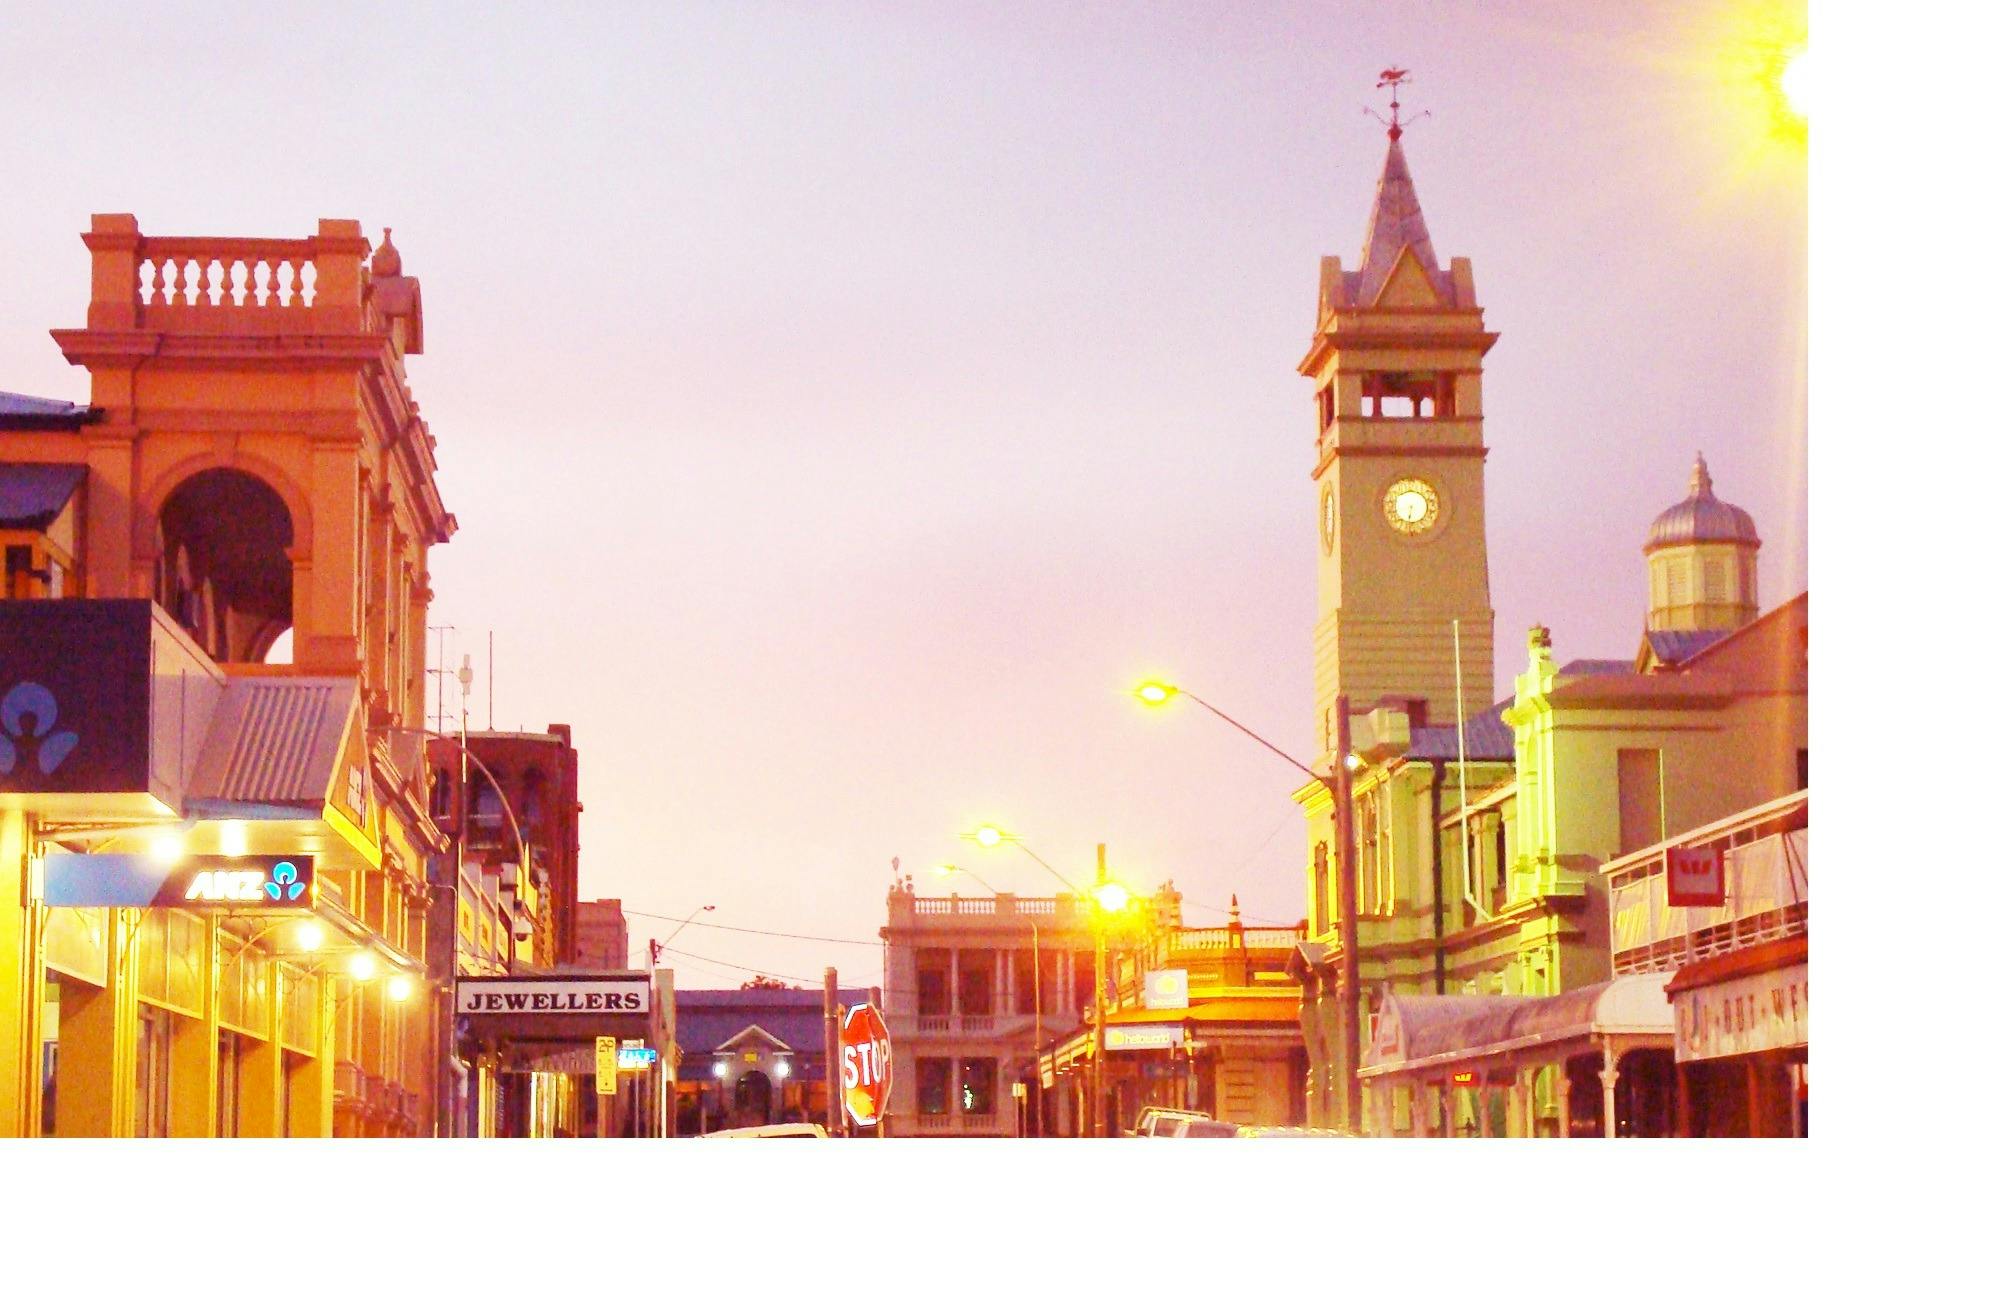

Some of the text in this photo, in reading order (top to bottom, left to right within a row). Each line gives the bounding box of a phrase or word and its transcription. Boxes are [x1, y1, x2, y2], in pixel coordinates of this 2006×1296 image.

[184, 870, 265, 901] ANZ
[467, 992, 641, 1010] JEWELLERS
[844, 1038, 890, 1089] STOP
